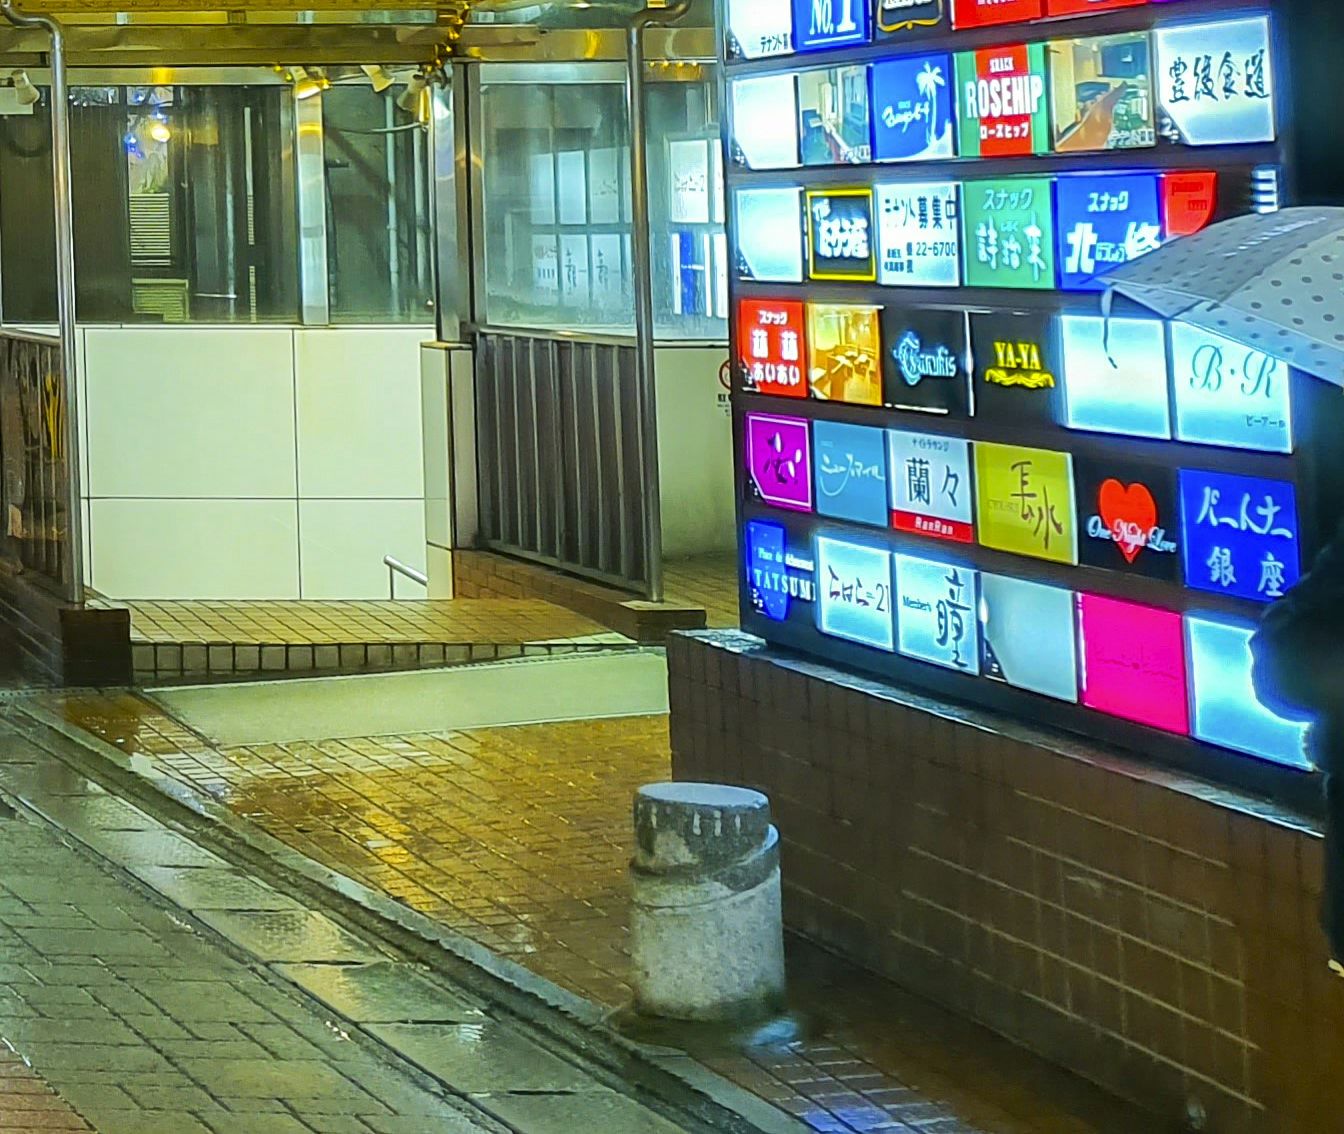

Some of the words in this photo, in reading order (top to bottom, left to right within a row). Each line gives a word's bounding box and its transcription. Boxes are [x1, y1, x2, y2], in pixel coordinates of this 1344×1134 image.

[966, 75, 1042, 117] ROSEHIP
[980, 121, 1029, 139] ローズヒップ
[983, 188, 1032, 210] スナック
[1088, 191, 1128, 212] スナック
[916, 241, 957, 257] 22-6700
[758, 310, 787, 325] スナック
[995, 343, 1041, 369] YA-YA
[754, 363, 799, 385] あいあい
[906, 457, 961, 507] 蘭々
[915, 517, 953, 535] RanRan
[1206, 546, 1284, 597] 銀座
[753, 569, 815, 601] TATSUMI
